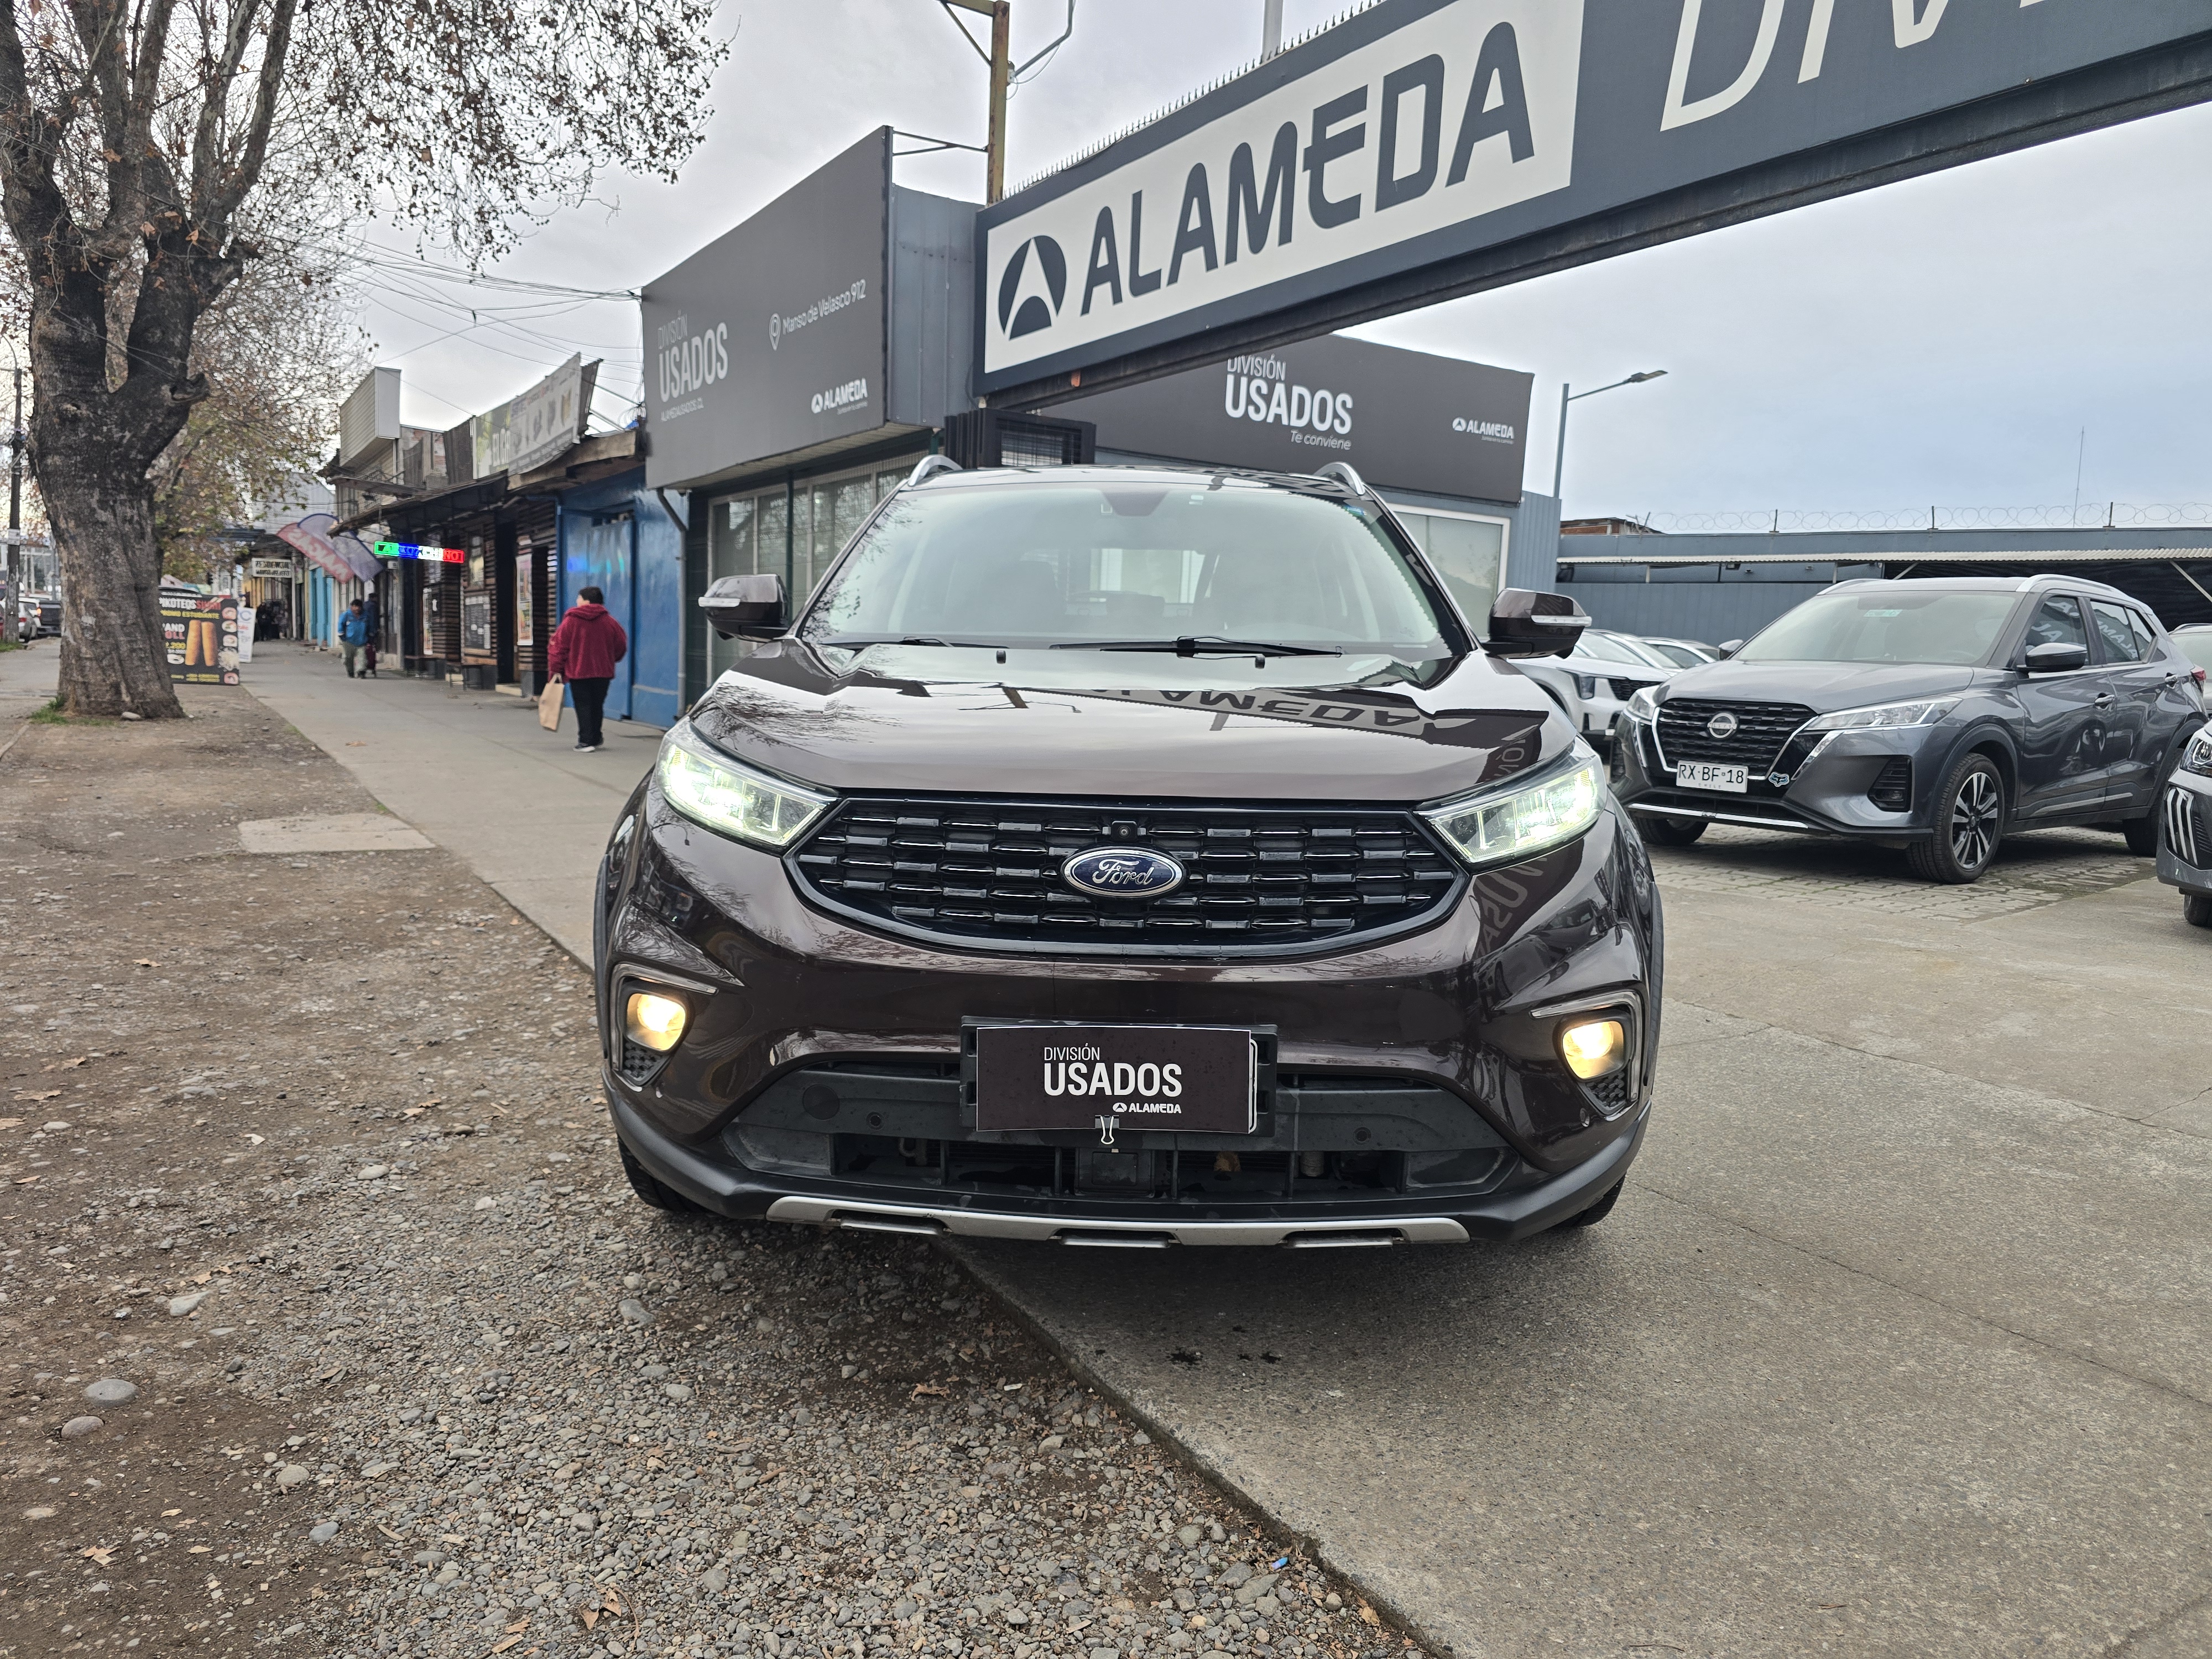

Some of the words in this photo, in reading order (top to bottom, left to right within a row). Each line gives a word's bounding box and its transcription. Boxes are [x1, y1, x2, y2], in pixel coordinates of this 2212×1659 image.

[1080, 21, 1535, 317] ALAMEDA
[807, 304, 818, 324] de
[818, 294, 851, 317] Velasco
[851, 278, 867, 302] 912
[659, 322, 728, 403] USADOS
[1227, 353, 1286, 381] DIVISIÓN
[823, 377, 868, 410] ALAMEDA
[1225, 373, 1353, 435] USADOS
[1291, 429, 1303, 443] Te
[1303, 435, 1352, 450] conviene
[1466, 419, 1515, 439] ALAMEDA
[163, 623, 185, 633] AND
[1092, 859, 1155, 885] Ford
[1044, 1042, 1100, 1061] DIVISIÓN
[1044, 1062, 1182, 1097] USADOS
[1128, 1103, 1182, 1114] ALAMEDA
